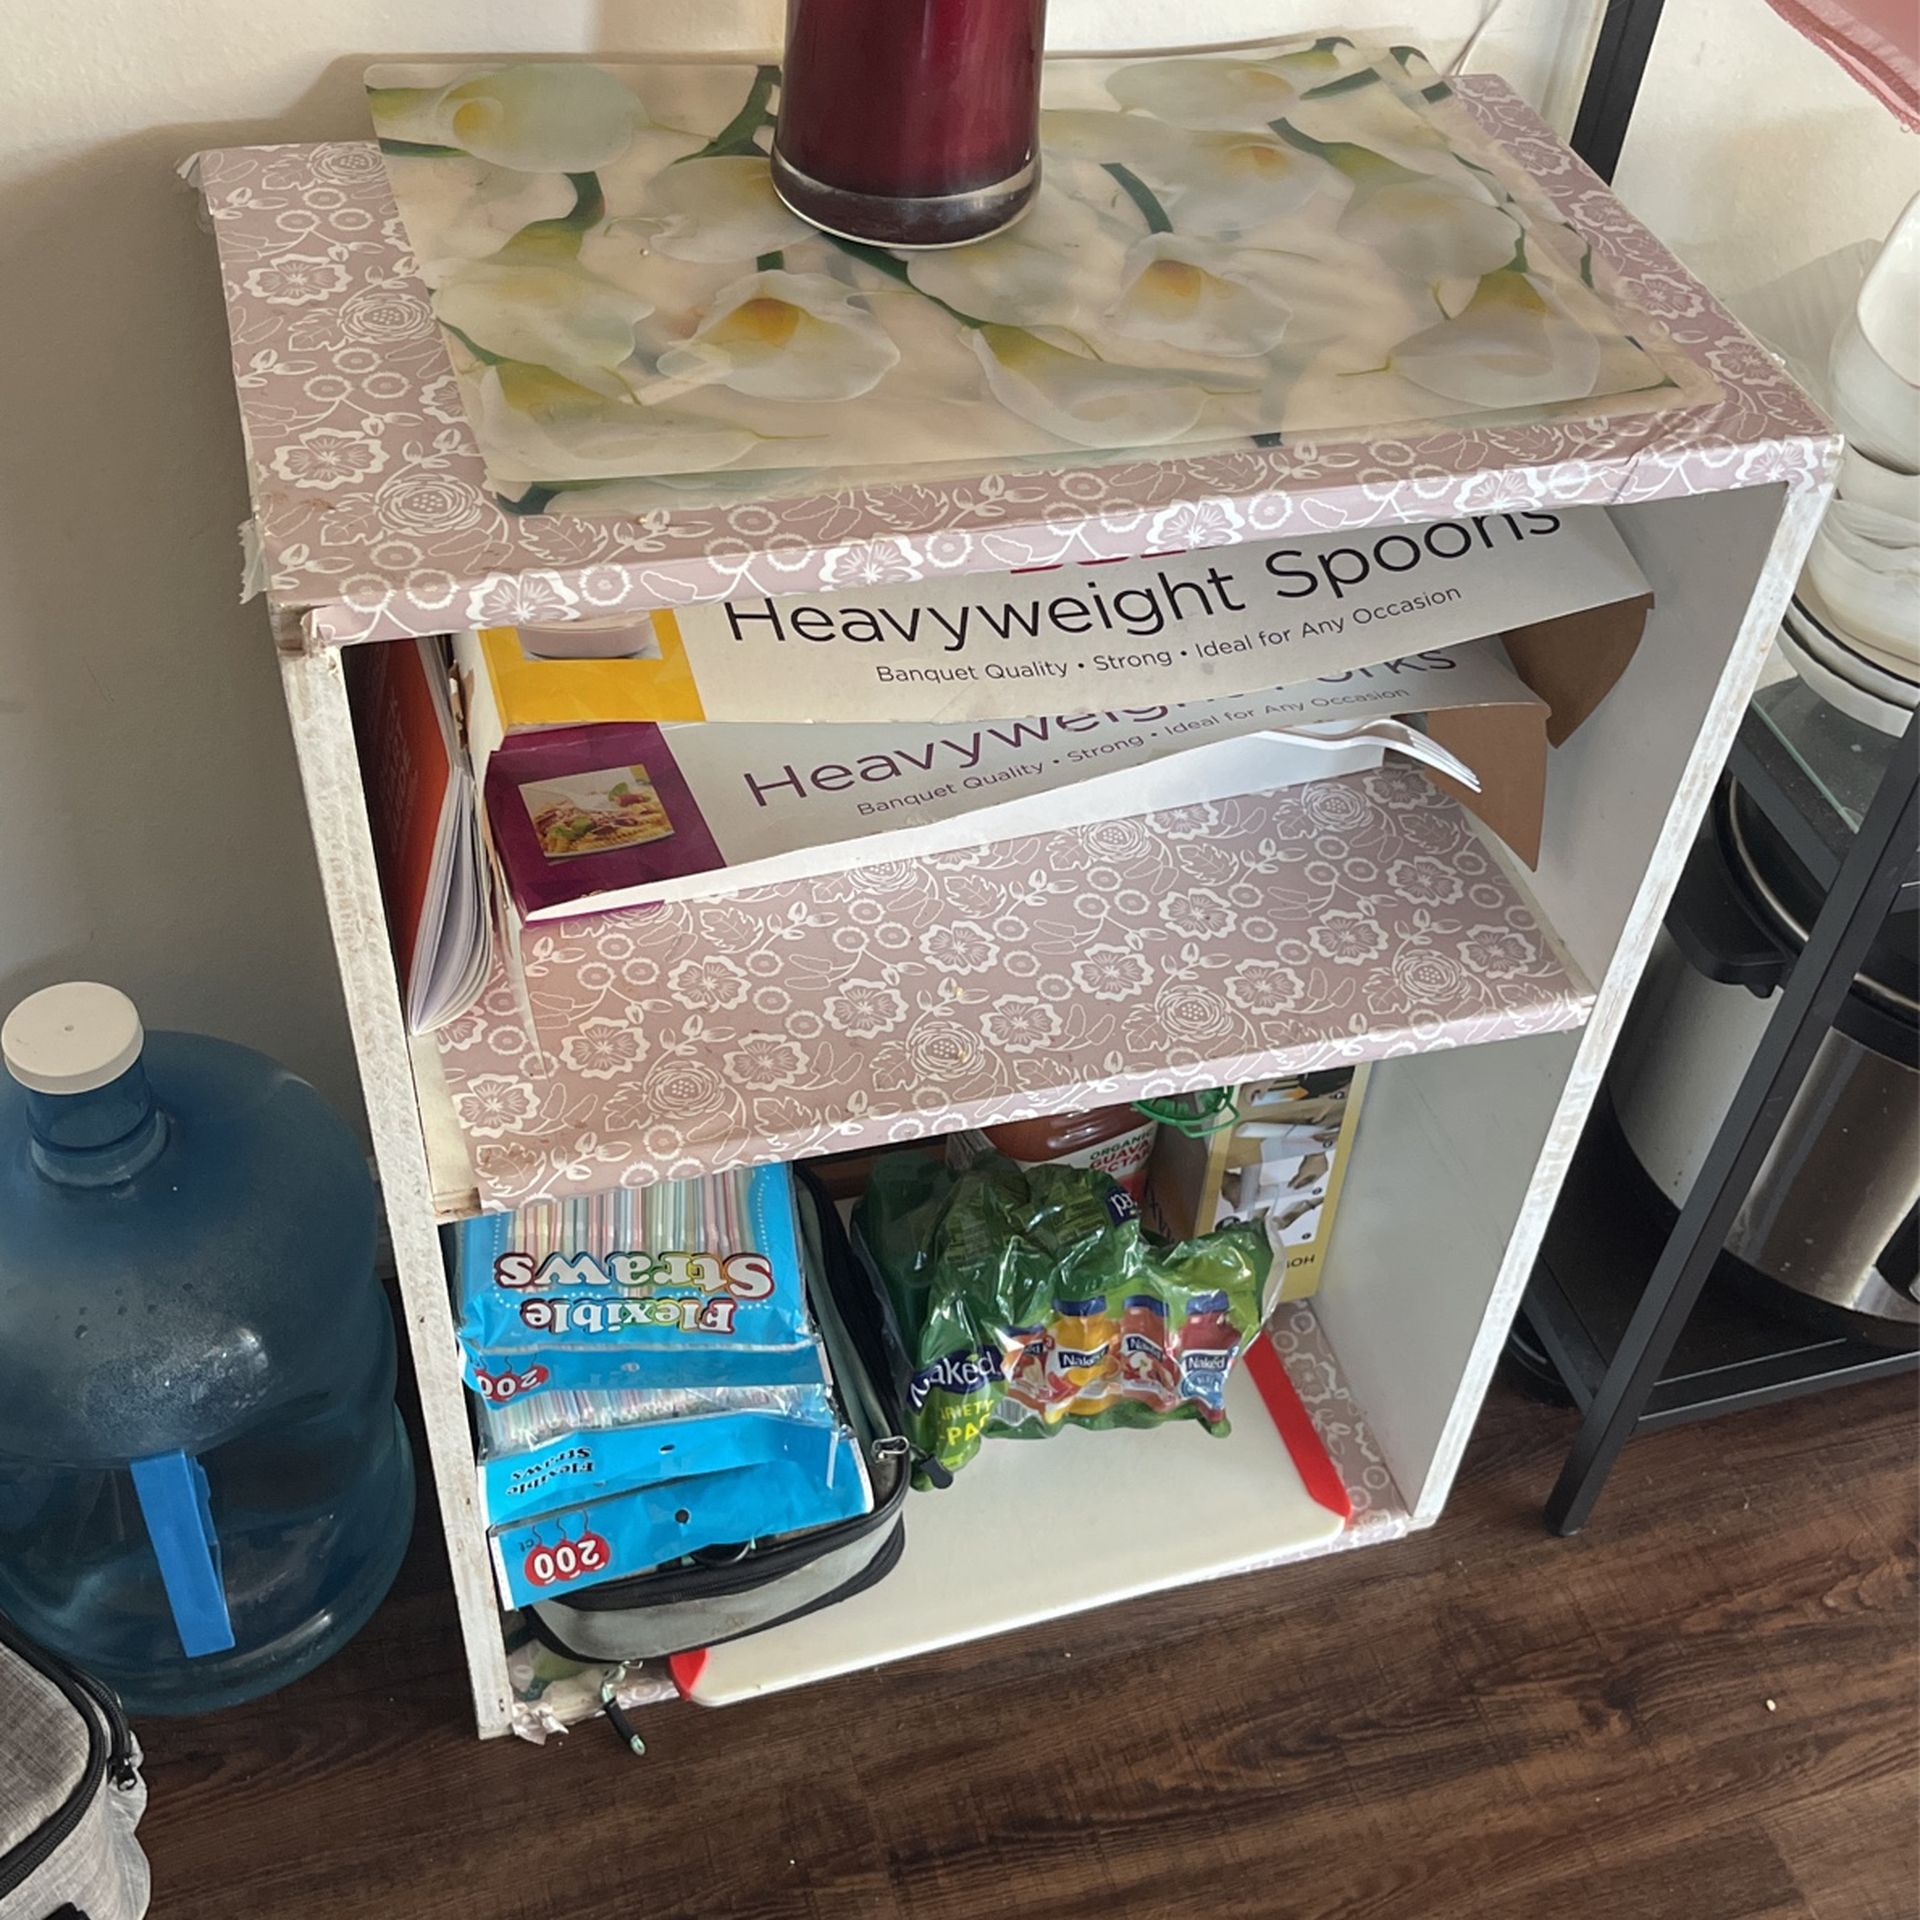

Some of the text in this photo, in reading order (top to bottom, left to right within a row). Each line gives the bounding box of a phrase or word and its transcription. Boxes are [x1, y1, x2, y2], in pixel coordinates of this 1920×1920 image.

[724, 512, 1561, 651] Heavyweight Spoons
[876, 585, 1462, 684] Banquet Quality Strong Ideal for Any Occasion
[857, 688, 1410, 816] Banquet Quality Strong Ideal for Any Occasion
[495, 1251, 775, 1299] Straws
[520, 1298, 737, 1335] Flexible
[909, 1350, 998, 1408] Naked
[506, 1462, 594, 1496] Flexible
[511, 1447, 593, 1481] Straws
[533, 1539, 600, 1580] 200
